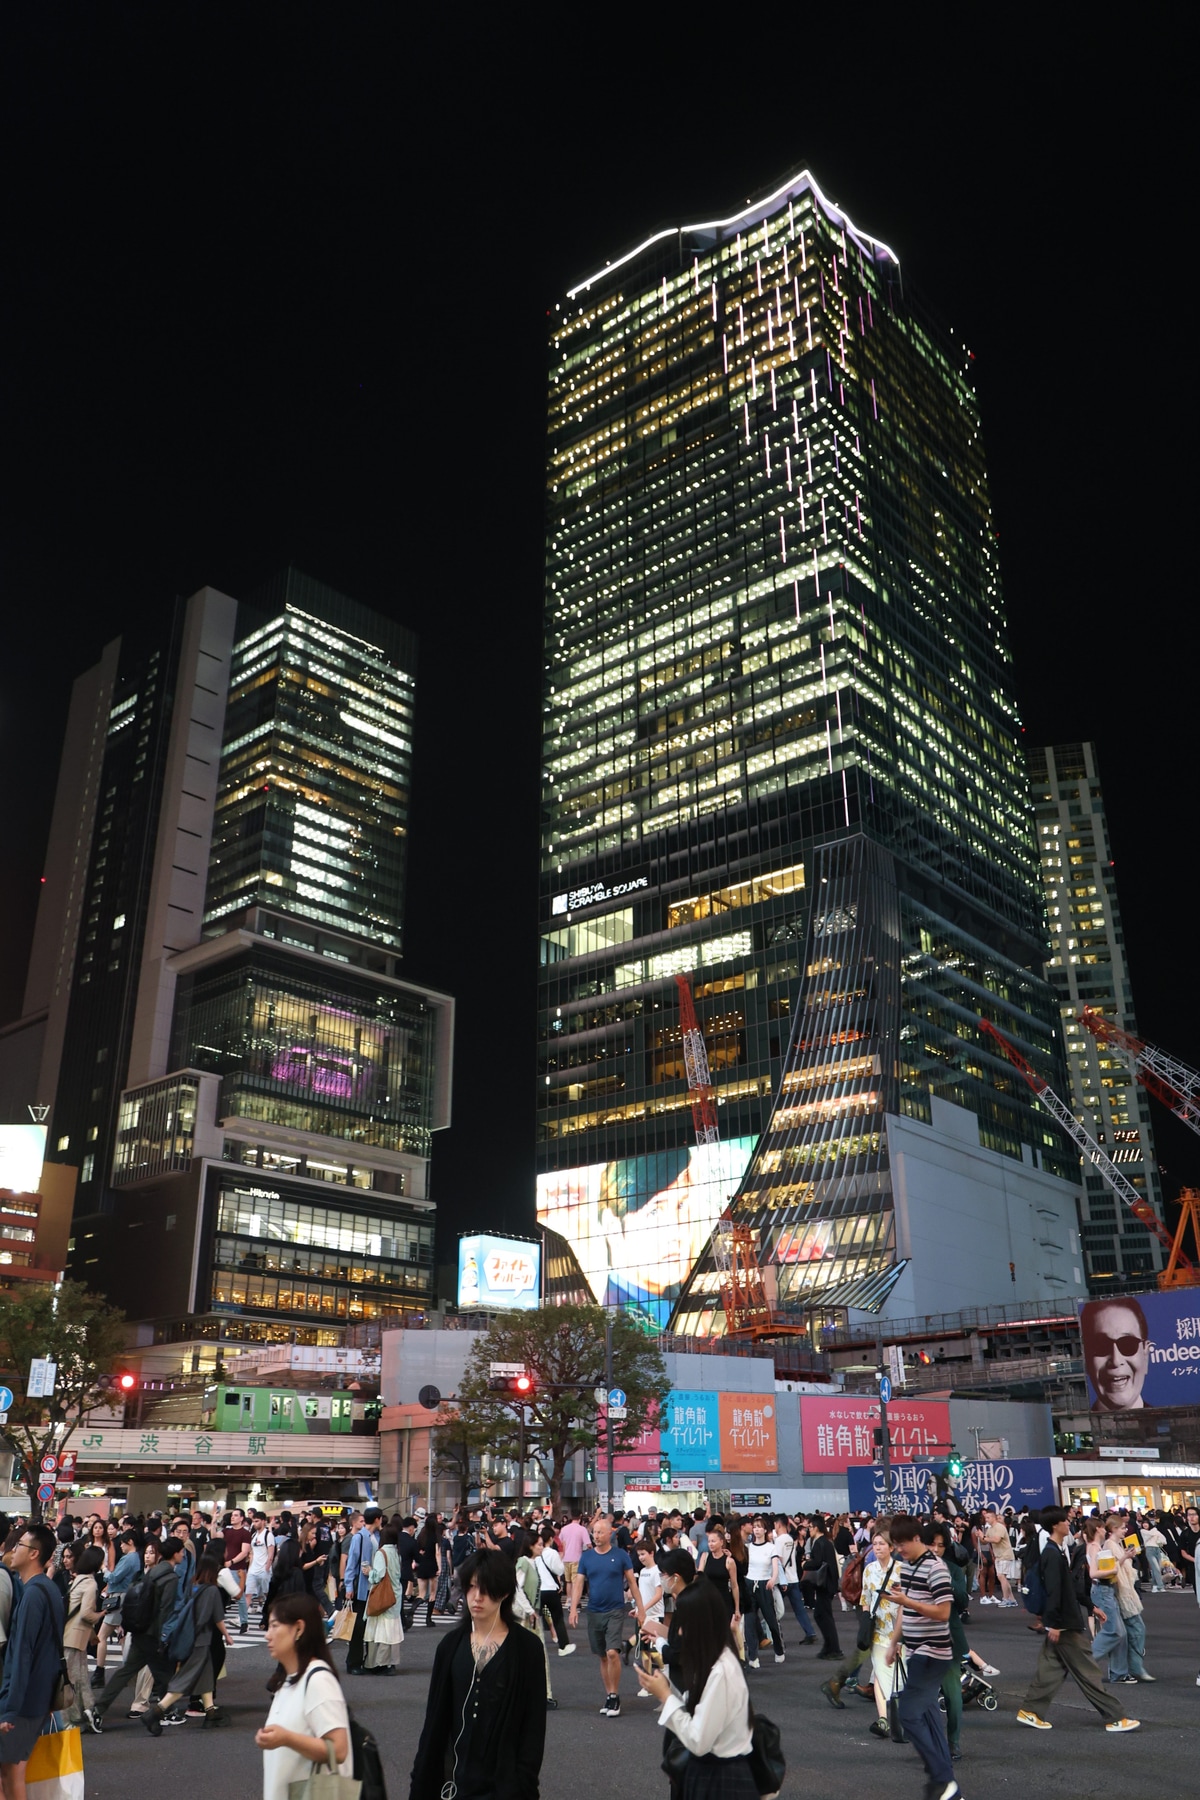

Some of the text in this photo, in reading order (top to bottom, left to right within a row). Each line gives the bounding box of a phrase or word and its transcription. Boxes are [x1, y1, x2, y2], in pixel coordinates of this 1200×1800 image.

[569, 883, 604, 900] SHIBUYA
[569, 877, 648, 909] SCRAMBLE SQUARE
[491, 1257, 528, 1271] ファイト
[674, 1406, 706, 1425] 龍角散
[732, 1408, 763, 1427] 龍角散
[82, 1434, 267, 1455] JR 渋谷駅
[817, 1423, 938, 1457] 龍角散イレクト
[872, 1463, 1014, 1494] この国の 採用の
